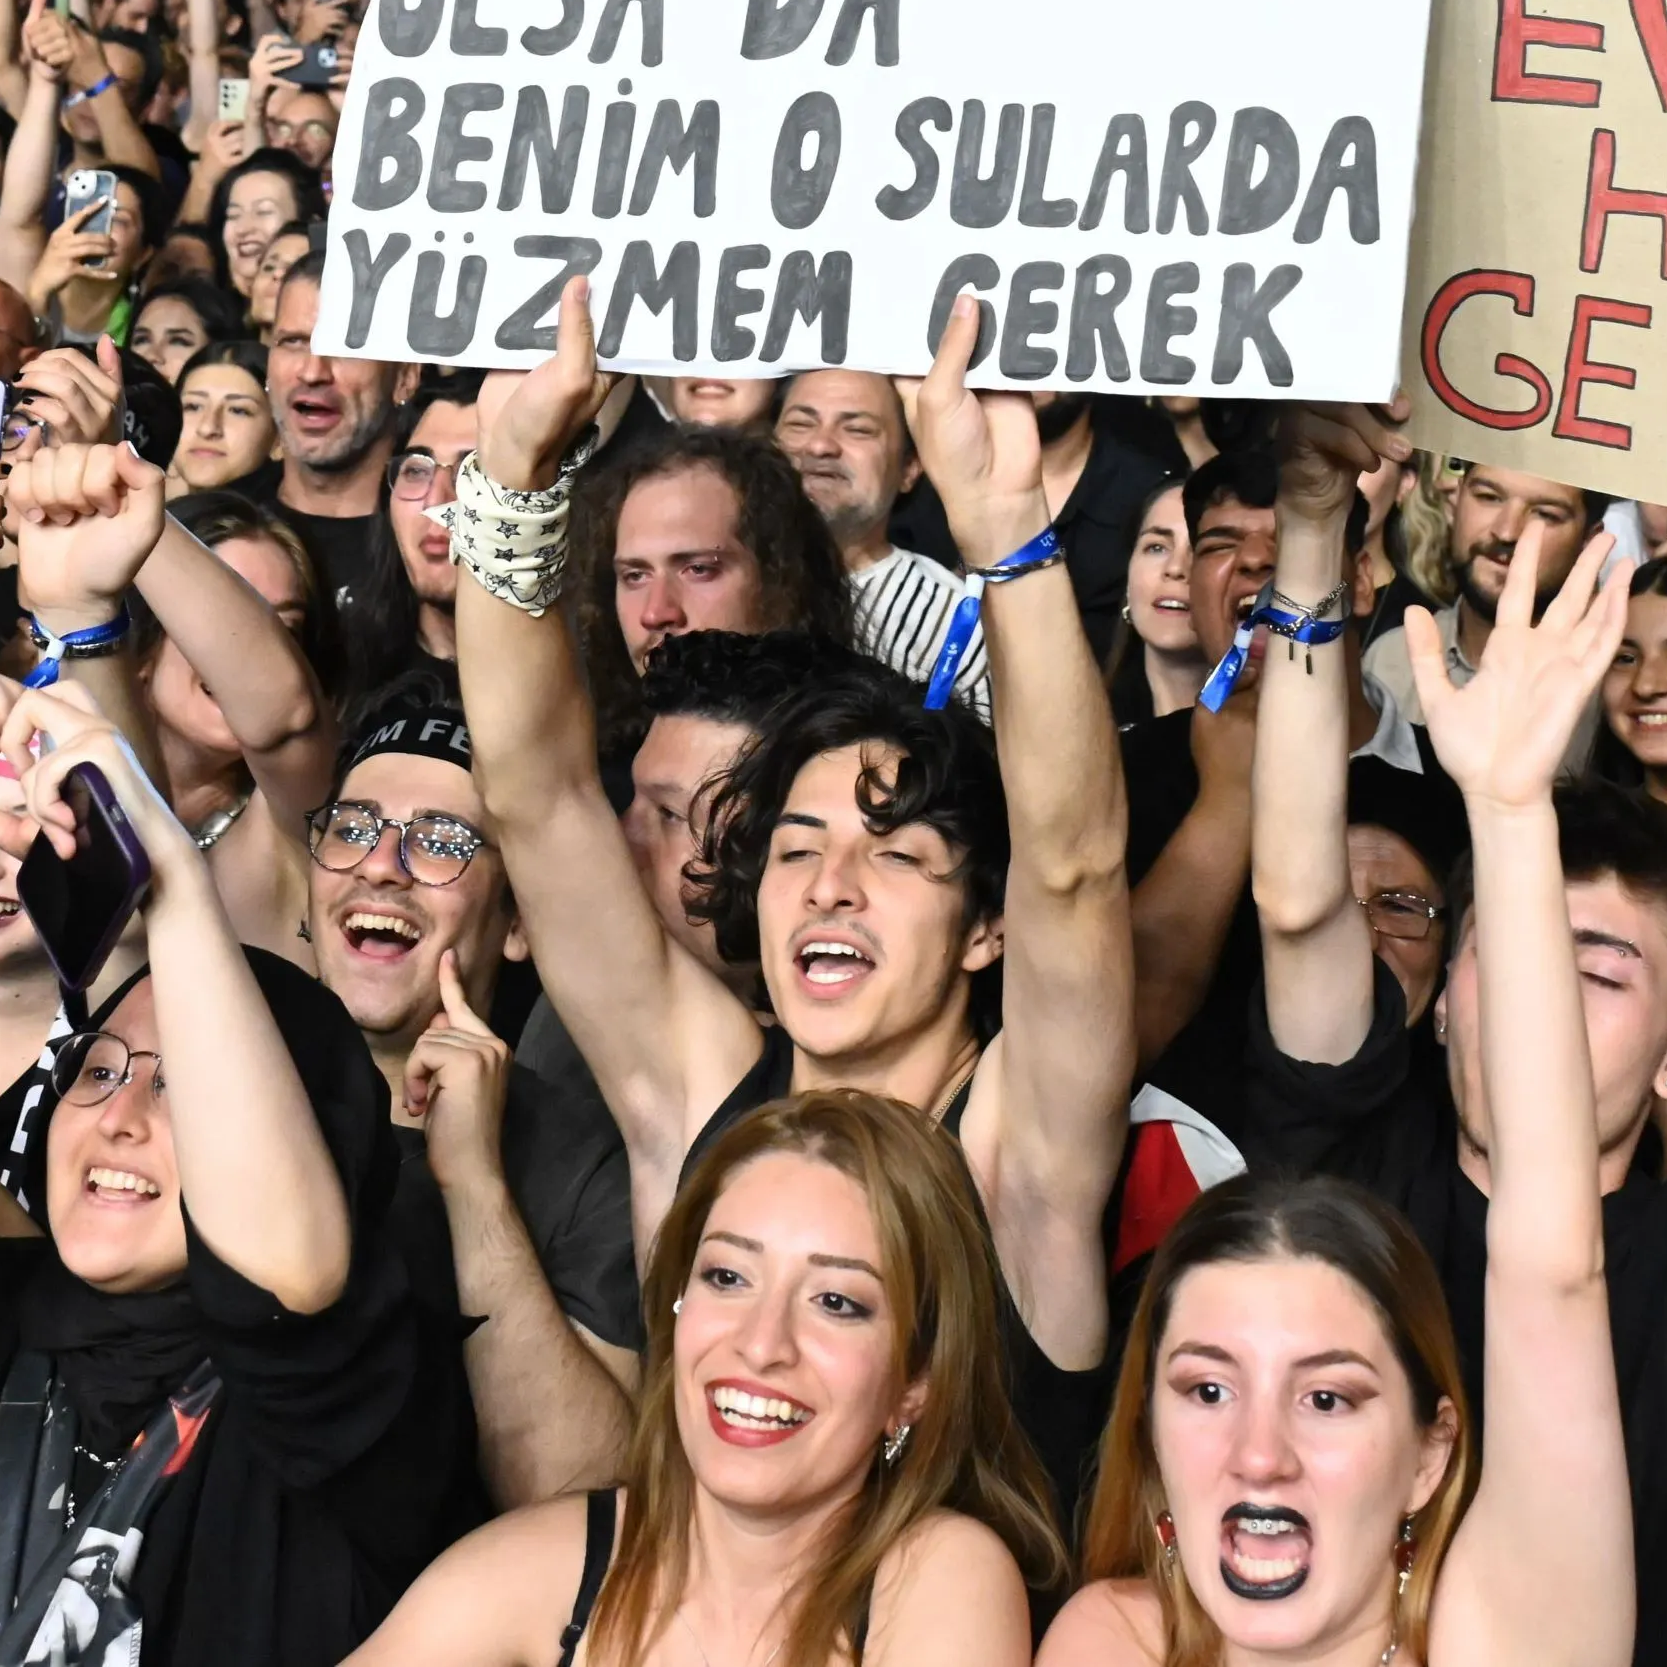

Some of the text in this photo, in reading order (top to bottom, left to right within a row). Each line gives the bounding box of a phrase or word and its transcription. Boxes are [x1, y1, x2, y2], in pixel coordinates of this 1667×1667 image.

[352, 77, 1380, 245] BENİM O SULARDA
[342, 228, 1302, 387] YÜZMEM GEREK
